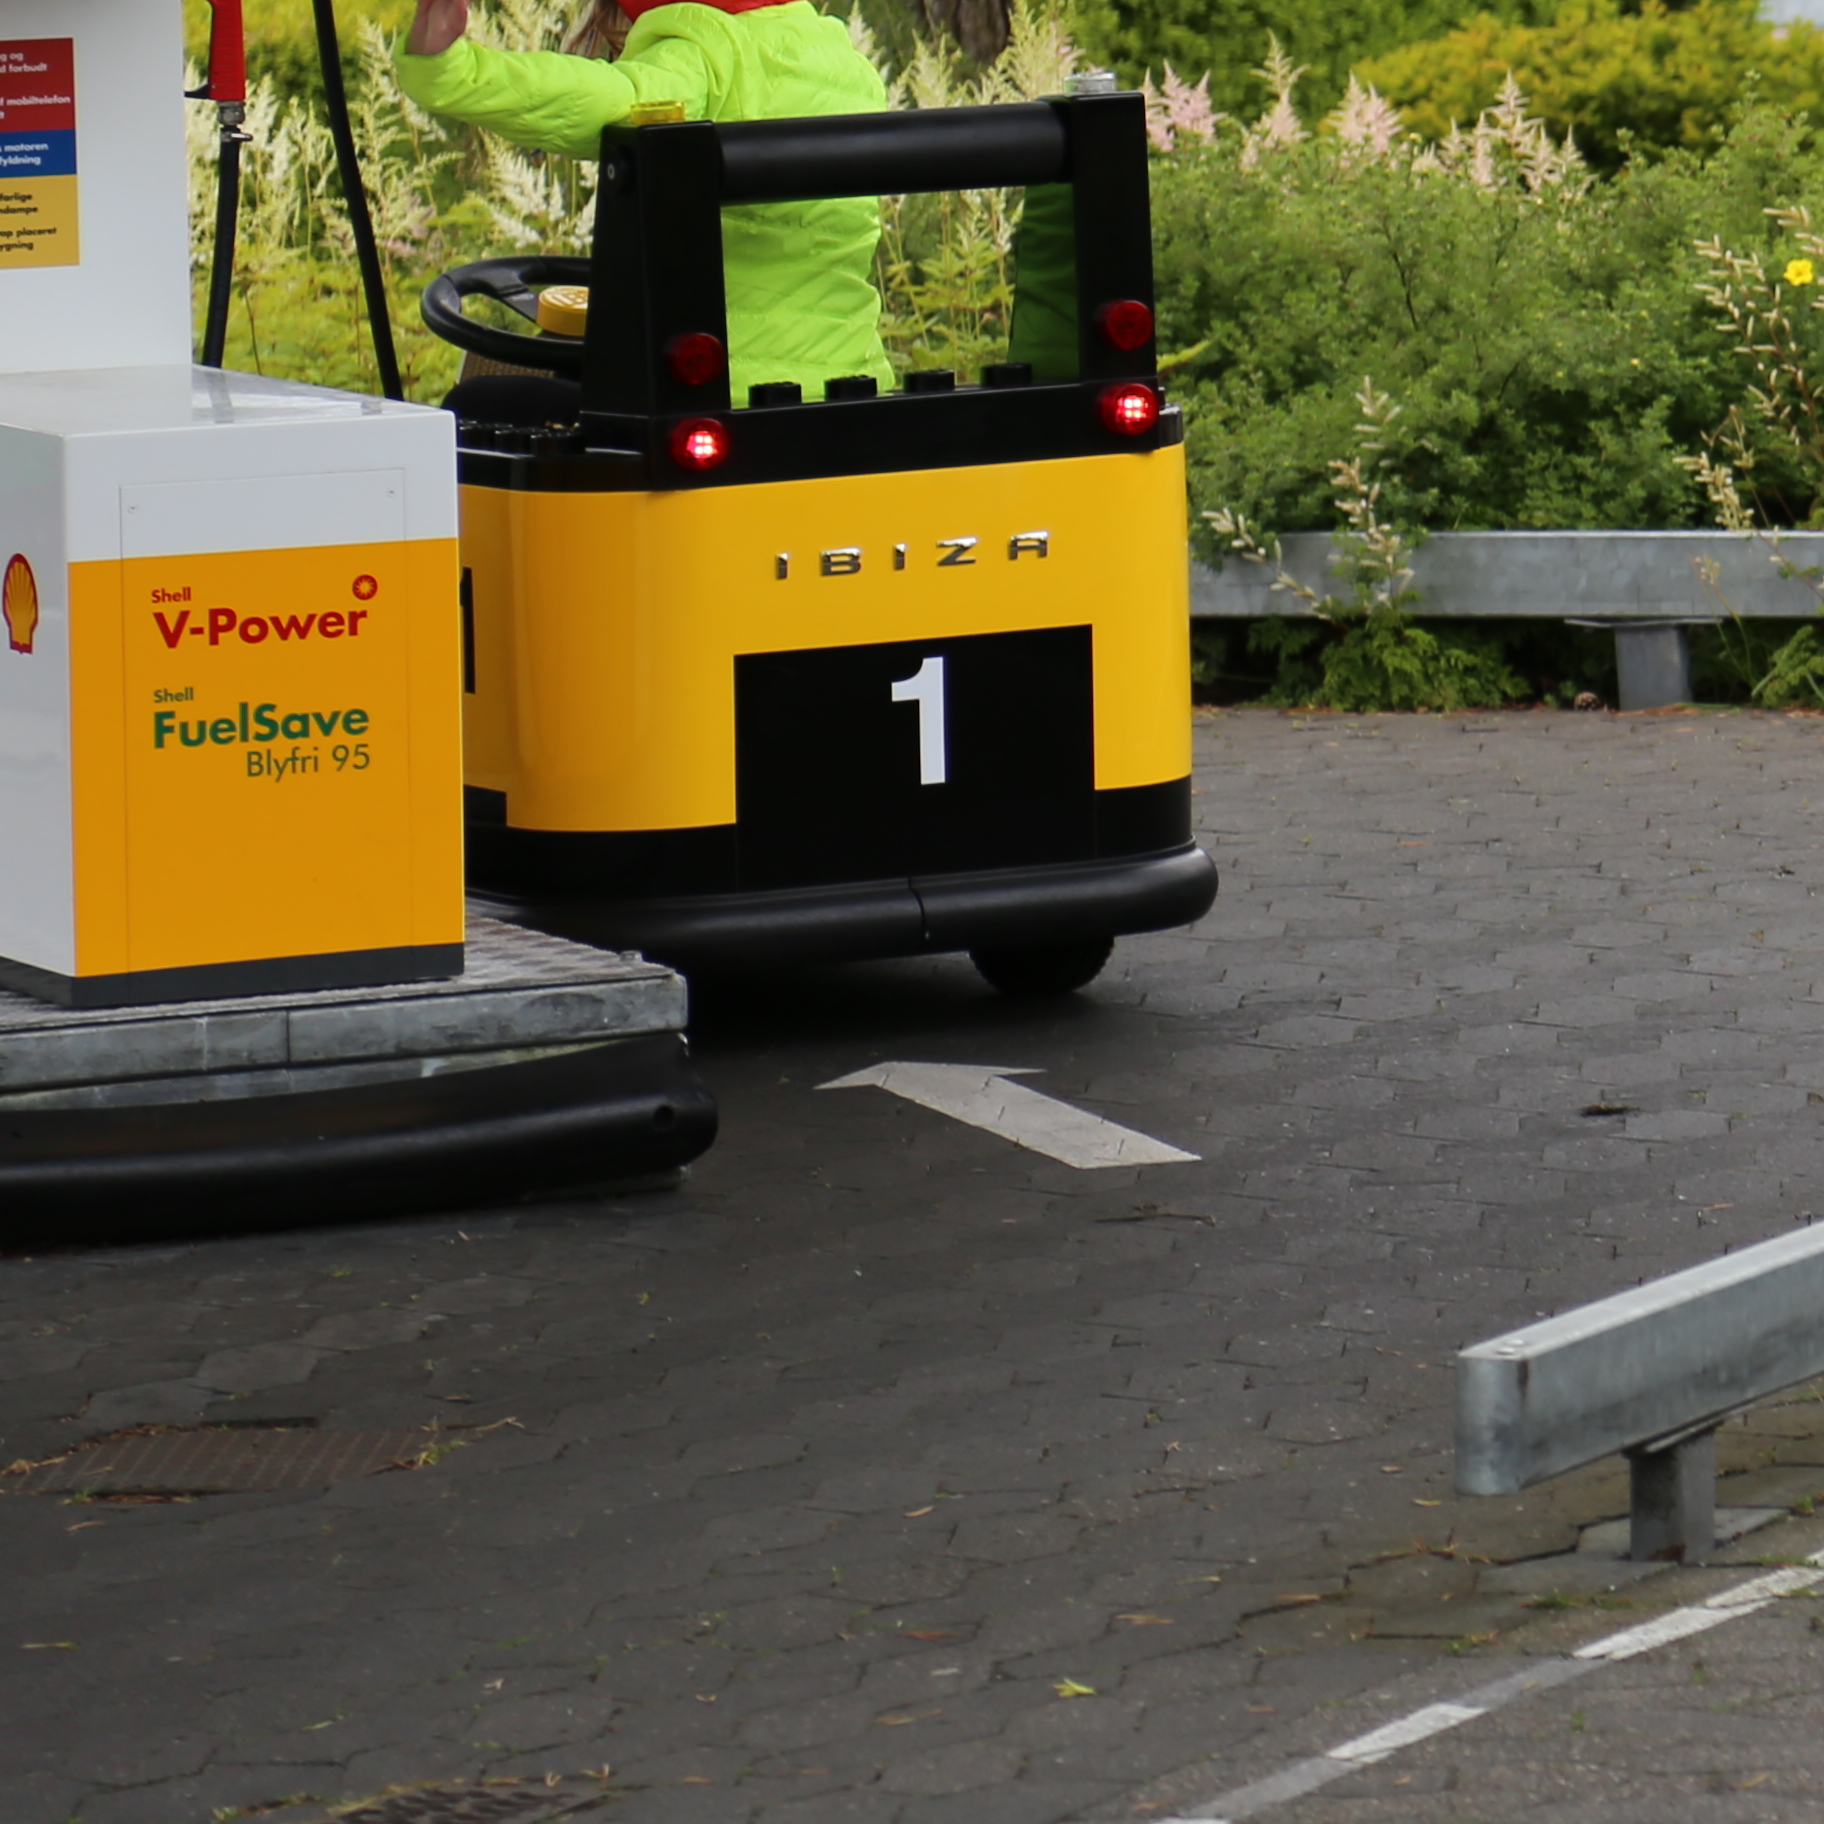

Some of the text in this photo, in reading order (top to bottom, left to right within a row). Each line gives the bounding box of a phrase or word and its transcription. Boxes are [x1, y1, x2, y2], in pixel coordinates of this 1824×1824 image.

[776, 530, 1050, 580] IBIZA
[151, 587, 192, 606] Shell
[153, 608, 368, 649] V-Power
[153, 687, 194, 705] Shell
[153, 702, 369, 749] FuelSave
[891, 656, 947, 785] 1
[246, 744, 371, 782] Blyfri 95
